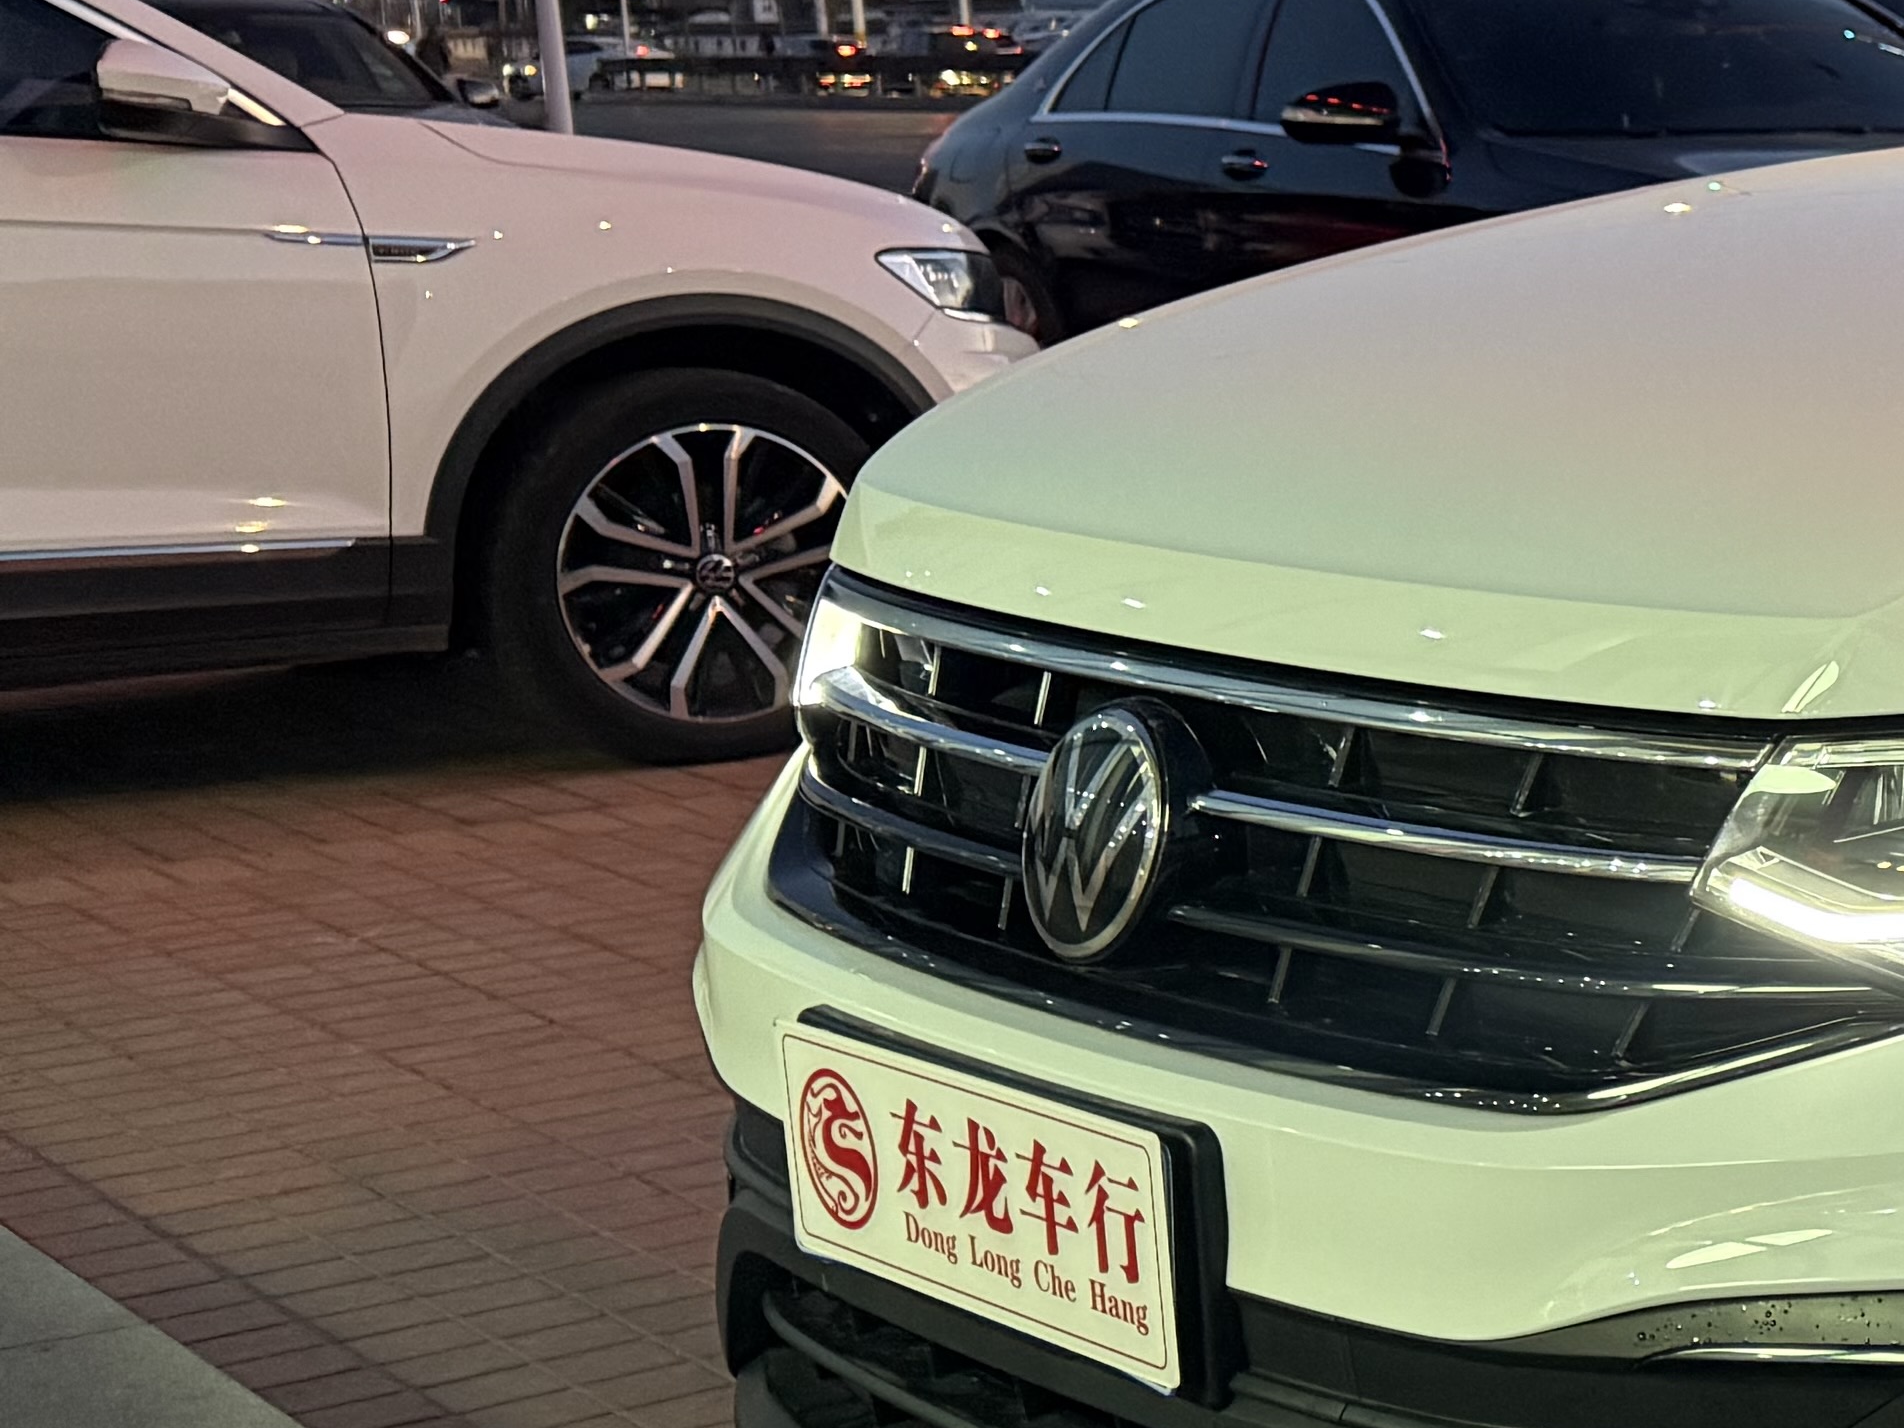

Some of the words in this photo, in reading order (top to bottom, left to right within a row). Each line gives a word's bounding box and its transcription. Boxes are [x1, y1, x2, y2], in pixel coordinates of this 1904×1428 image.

[890, 1098, 1146, 1284] 东龙车行
[903, 1211, 957, 1264] Dong
[969, 1234, 1022, 1289] Long
[1034, 1260, 1077, 1302] Che
[1089, 1278, 1149, 1336] Hang
